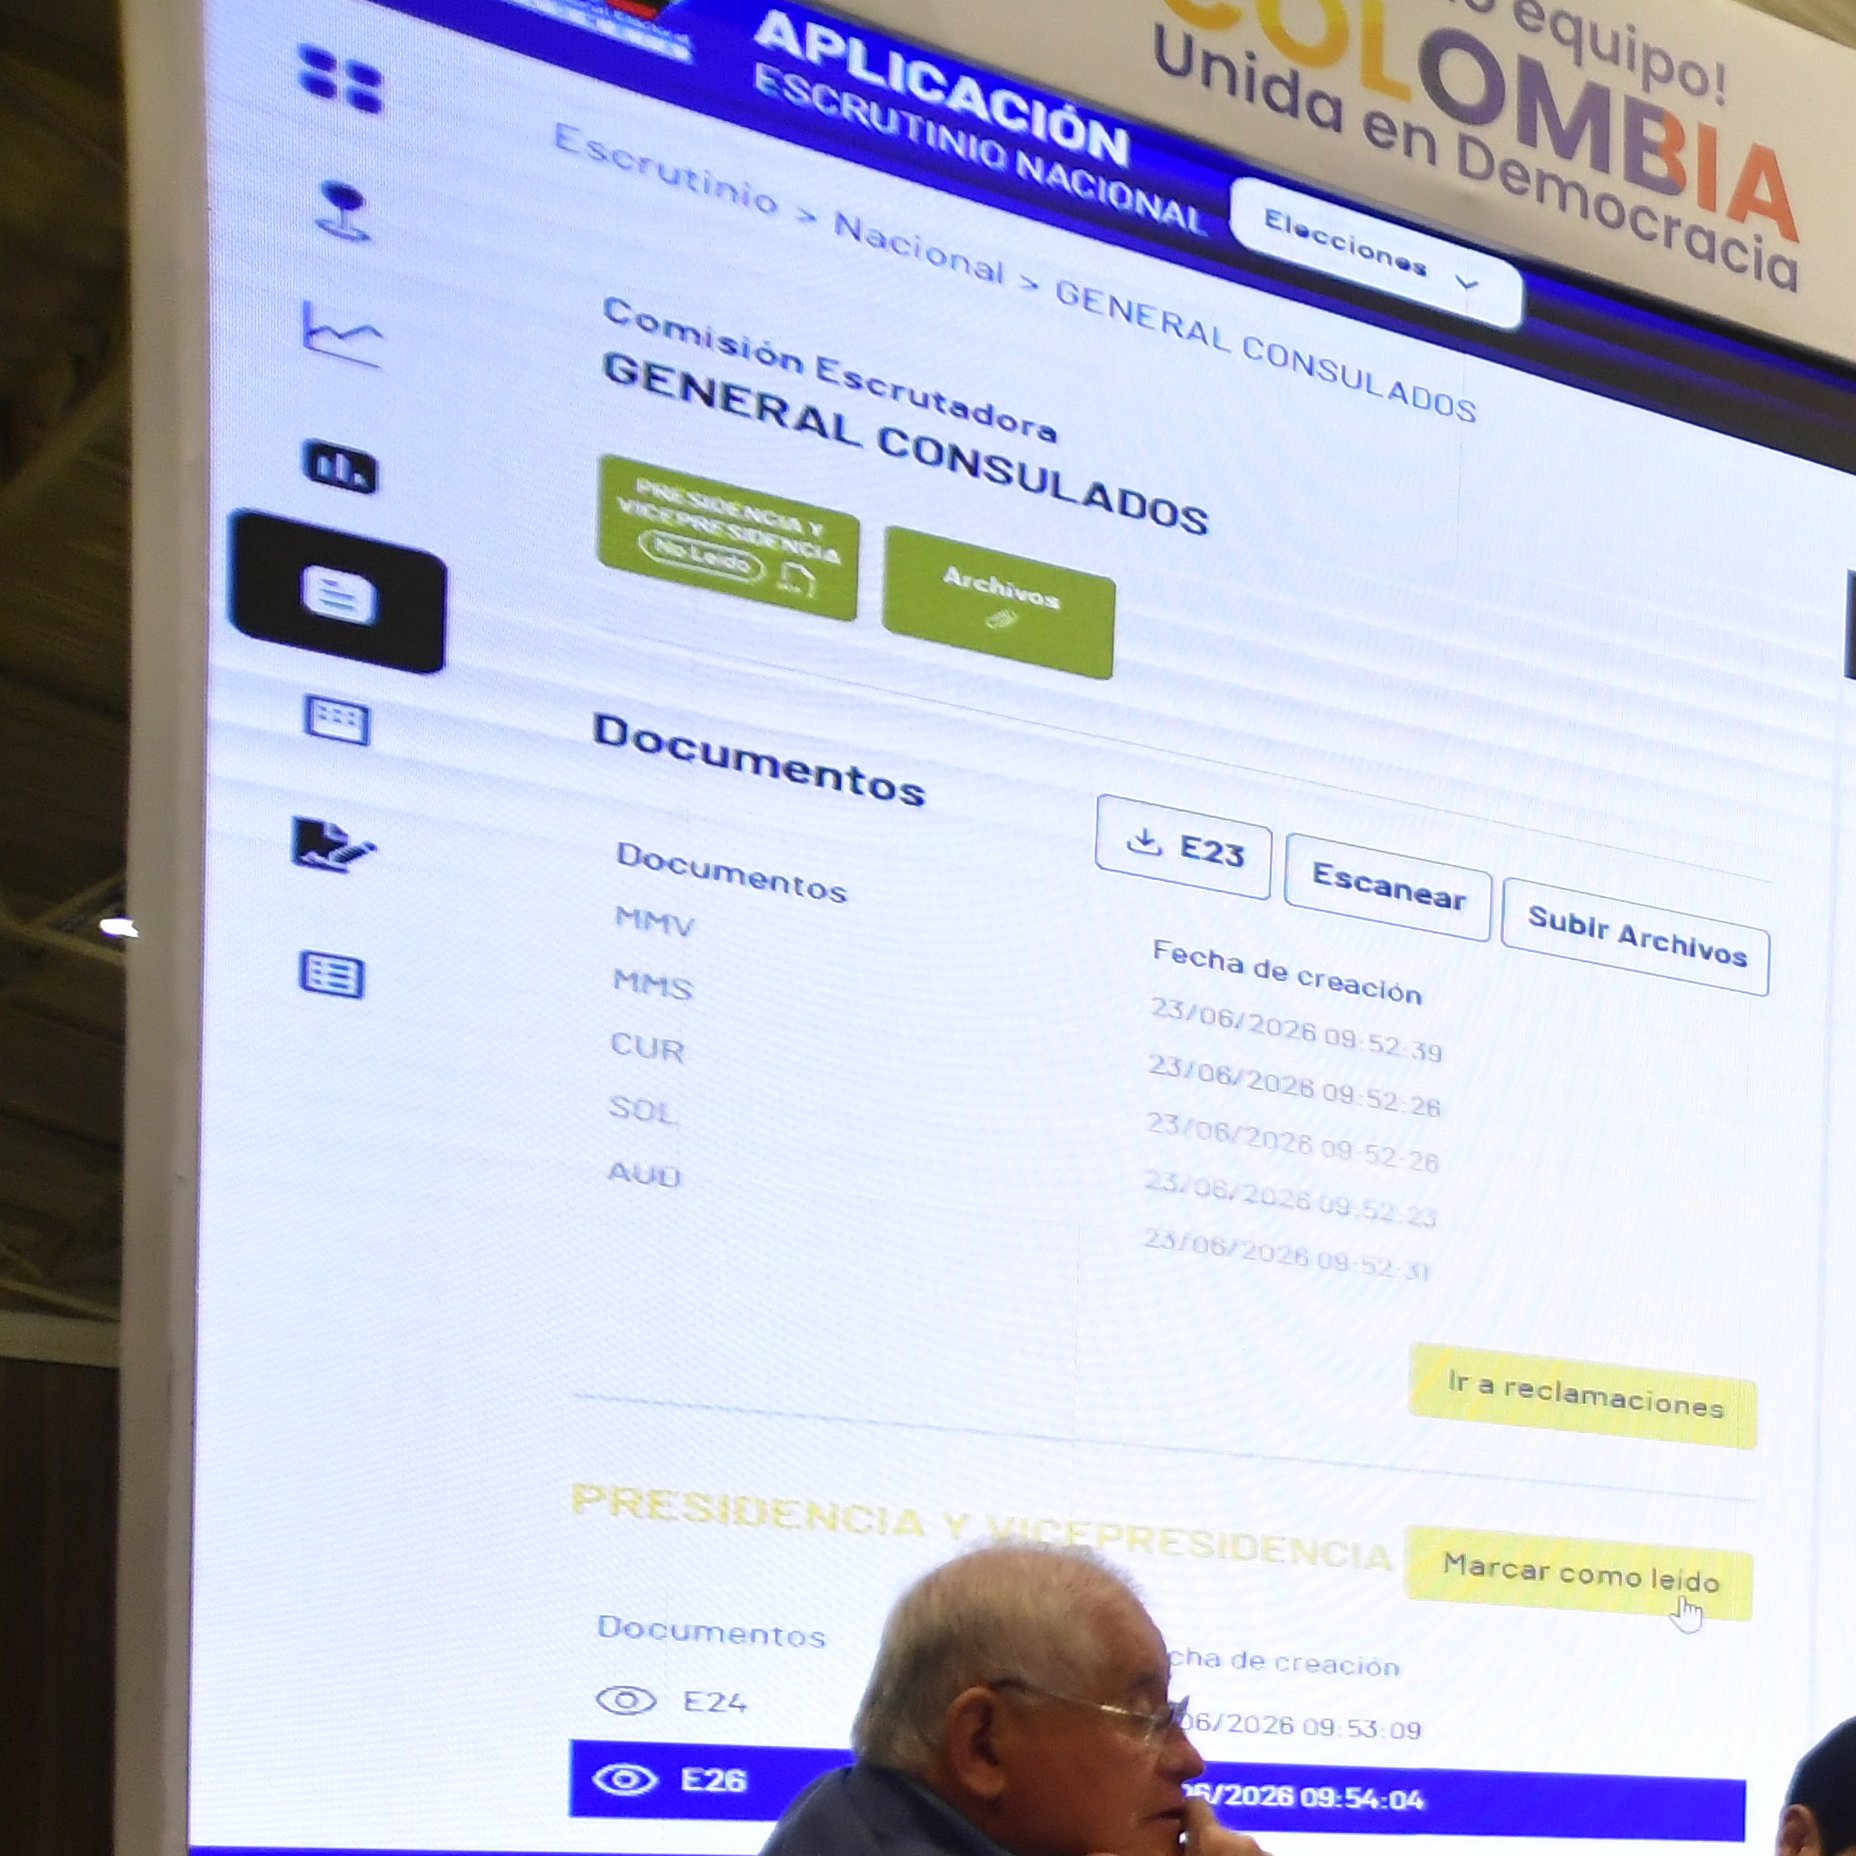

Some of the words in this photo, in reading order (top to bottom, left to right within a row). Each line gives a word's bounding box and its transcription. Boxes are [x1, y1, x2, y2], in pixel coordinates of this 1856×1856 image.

[753, 8, 1130, 169] APLICACIÓN
[1513, 0, 1728, 107] equipo!
[752, 61, 1006, 173] ESCRUTINIO
[1015, 148, 1209, 238] NACIONAL
[1154, 22, 1343, 134] Unida
[1364, 108, 1437, 167] en
[1457, 132, 1800, 294] Democracia
[1160, 0, 1801, 245] OLOMBIA
[553, 120, 780, 217] Escrutinio
[834, 211, 1004, 286] Nacional
[1055, 279, 1232, 354] GENERAL
[1242, 336, 1478, 425] CONSULADOS
[1263, 207, 1429, 279] Elecciones
[602, 295, 804, 374] Comisión
[816, 357, 1059, 445] Escrutadora
[601, 352, 862, 448] GENERAL
[876, 424, 1211, 537] CONSULADOS
[616, 496, 842, 566] VICEPRESIDENCIA
[635, 477, 802, 535] PRESIDENCIA
[810, 521, 825, 539] Y
[942, 565, 1060, 610] Archivos
[591, 712, 927, 807] Documentos
[1179, 834, 1245, 870] E23
[1312, 860, 1468, 912] Escanear
[616, 841, 849, 905] Documentos
[1152, 938, 1246, 977] Fecha
[1253, 957, 1290, 984] de
[1297, 967, 1424, 1007] creación
[1528, 904, 1609, 943] Subir
[1617, 923, 1749, 968] Archivos
[615, 905, 696, 939] MMV
[1151, 996, 1318, 1044] 23/06/2026
[1323, 1026, 1444, 1066] 09:52:39
[613, 967, 695, 1002] MMS
[1148, 1054, 1315, 1100] 23/06/2026
[1321, 1082, 1442, 1119] 09:52:26
[610, 1031, 685, 1065] CUR
[1146, 1111, 1313, 1156] 23/06/2026
[1320, 1138, 1440, 1175] 09:52:26
[608, 1095, 680, 1125] SOL
[1143, 1168, 1312, 1213] 23/06/2026
[606, 1160, 682, 1190] AUD
[1143, 1227, 1311, 1268] 23/06/2026
[1449, 1369, 1470, 1394] Ir
[1478, 1376, 1496, 1396] a
[1503, 1376, 1725, 1420] reclamaciones
[570, 1482, 926, 1540] PRESIDENCIA
[940, 1511, 972, 1542] Y
[986, 1514, 1395, 1572] VICEPRESIDENCIA
[1442, 1551, 1550, 1584] Marcar
[1559, 1565, 1643, 1590] como
[597, 1615, 827, 1650] Documentos
[1230, 1650, 1265, 1671] de
[1275, 1656, 1401, 1677] creación
[683, 1690, 748, 1715] E24
[1302, 1717, 1422, 1741] 09:53:09
[681, 1768, 749, 1794] E26
[1300, 1786, 1426, 1811] 09:54:04
